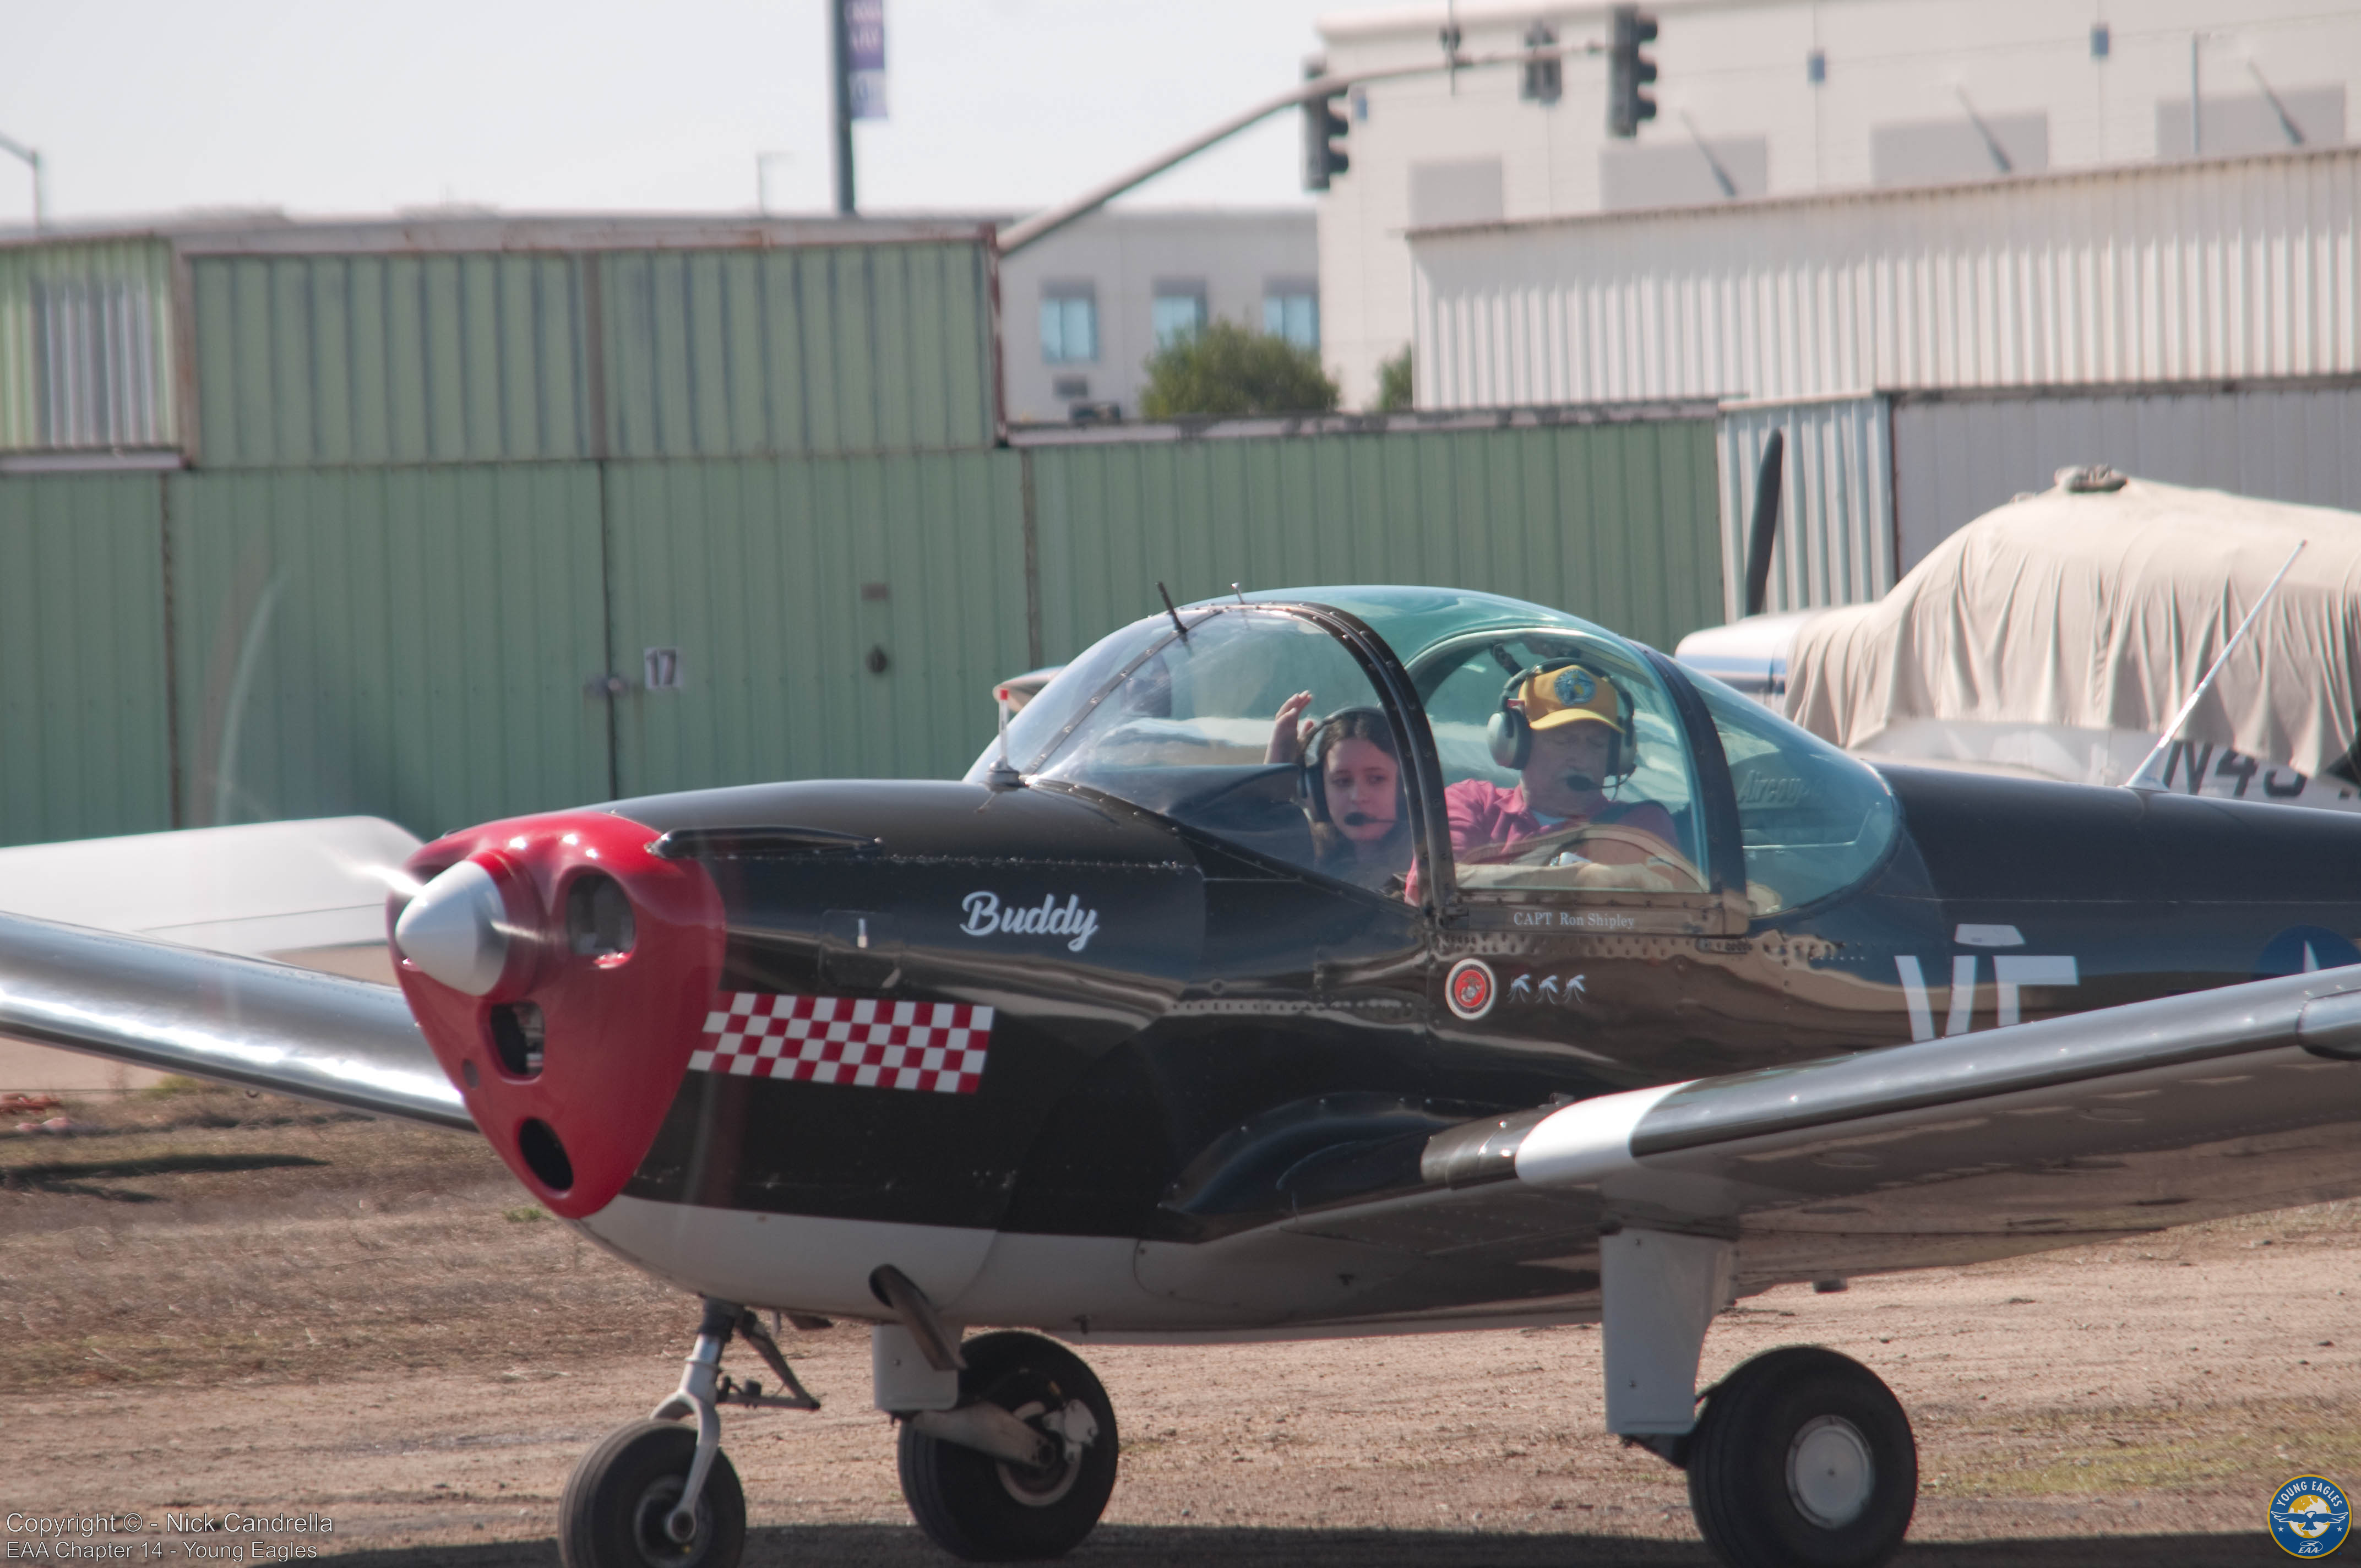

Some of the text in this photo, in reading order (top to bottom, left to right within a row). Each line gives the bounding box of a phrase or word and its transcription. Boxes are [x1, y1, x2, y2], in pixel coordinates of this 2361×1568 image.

[646, 649, 676, 687] 17
[959, 890, 1100, 952] Buddy
[1513, 911, 1635, 929] CAPT Ron Shipley
